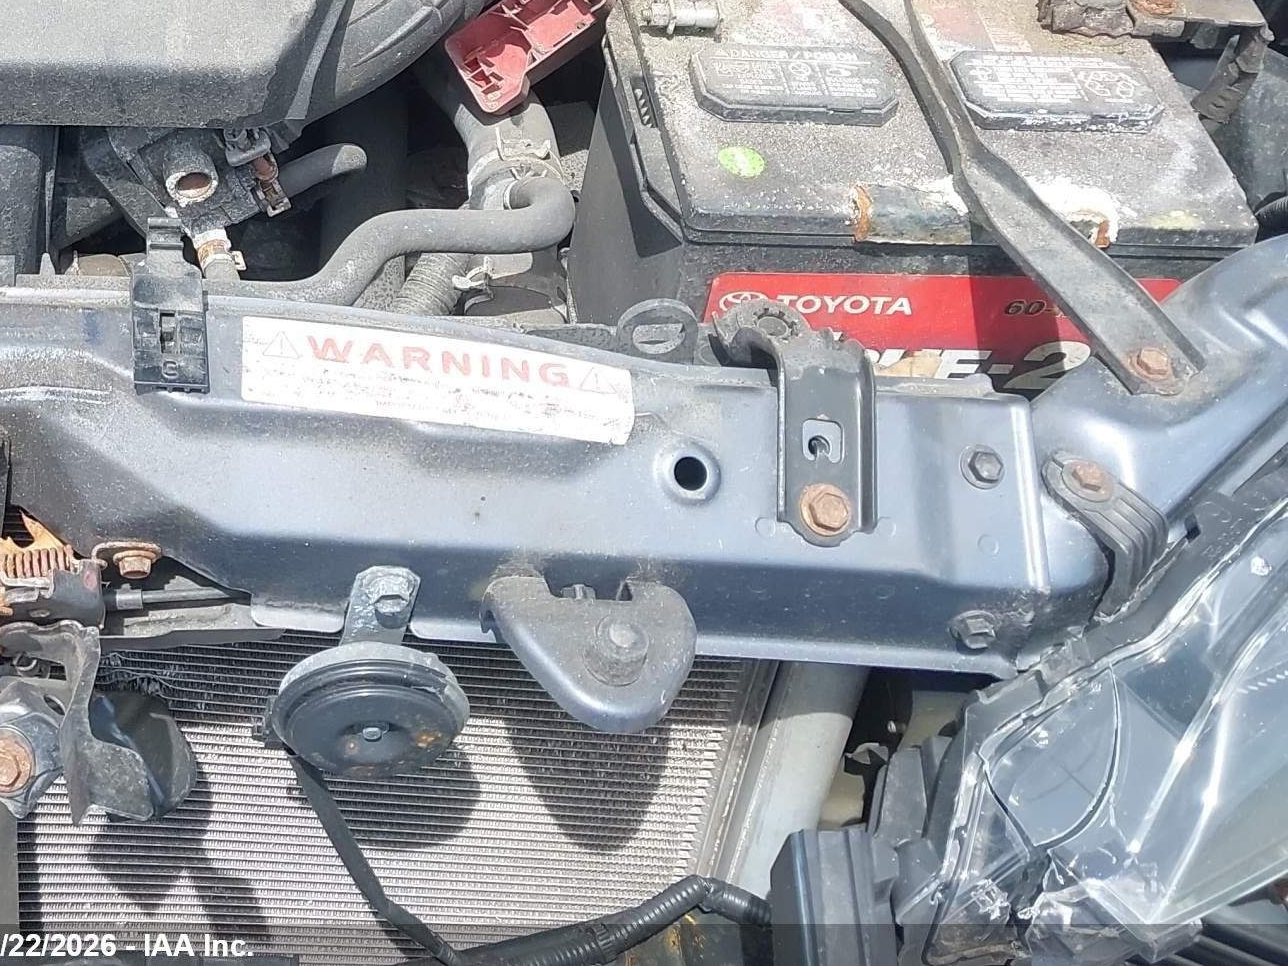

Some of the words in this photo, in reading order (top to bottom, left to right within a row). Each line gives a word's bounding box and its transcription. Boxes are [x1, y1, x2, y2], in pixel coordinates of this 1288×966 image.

[730, 49, 789, 59] DANGER
[804, 51, 858, 61] POISON
[777, 294, 912, 315] TOYOTA
[306, 334, 570, 388] WARNING
